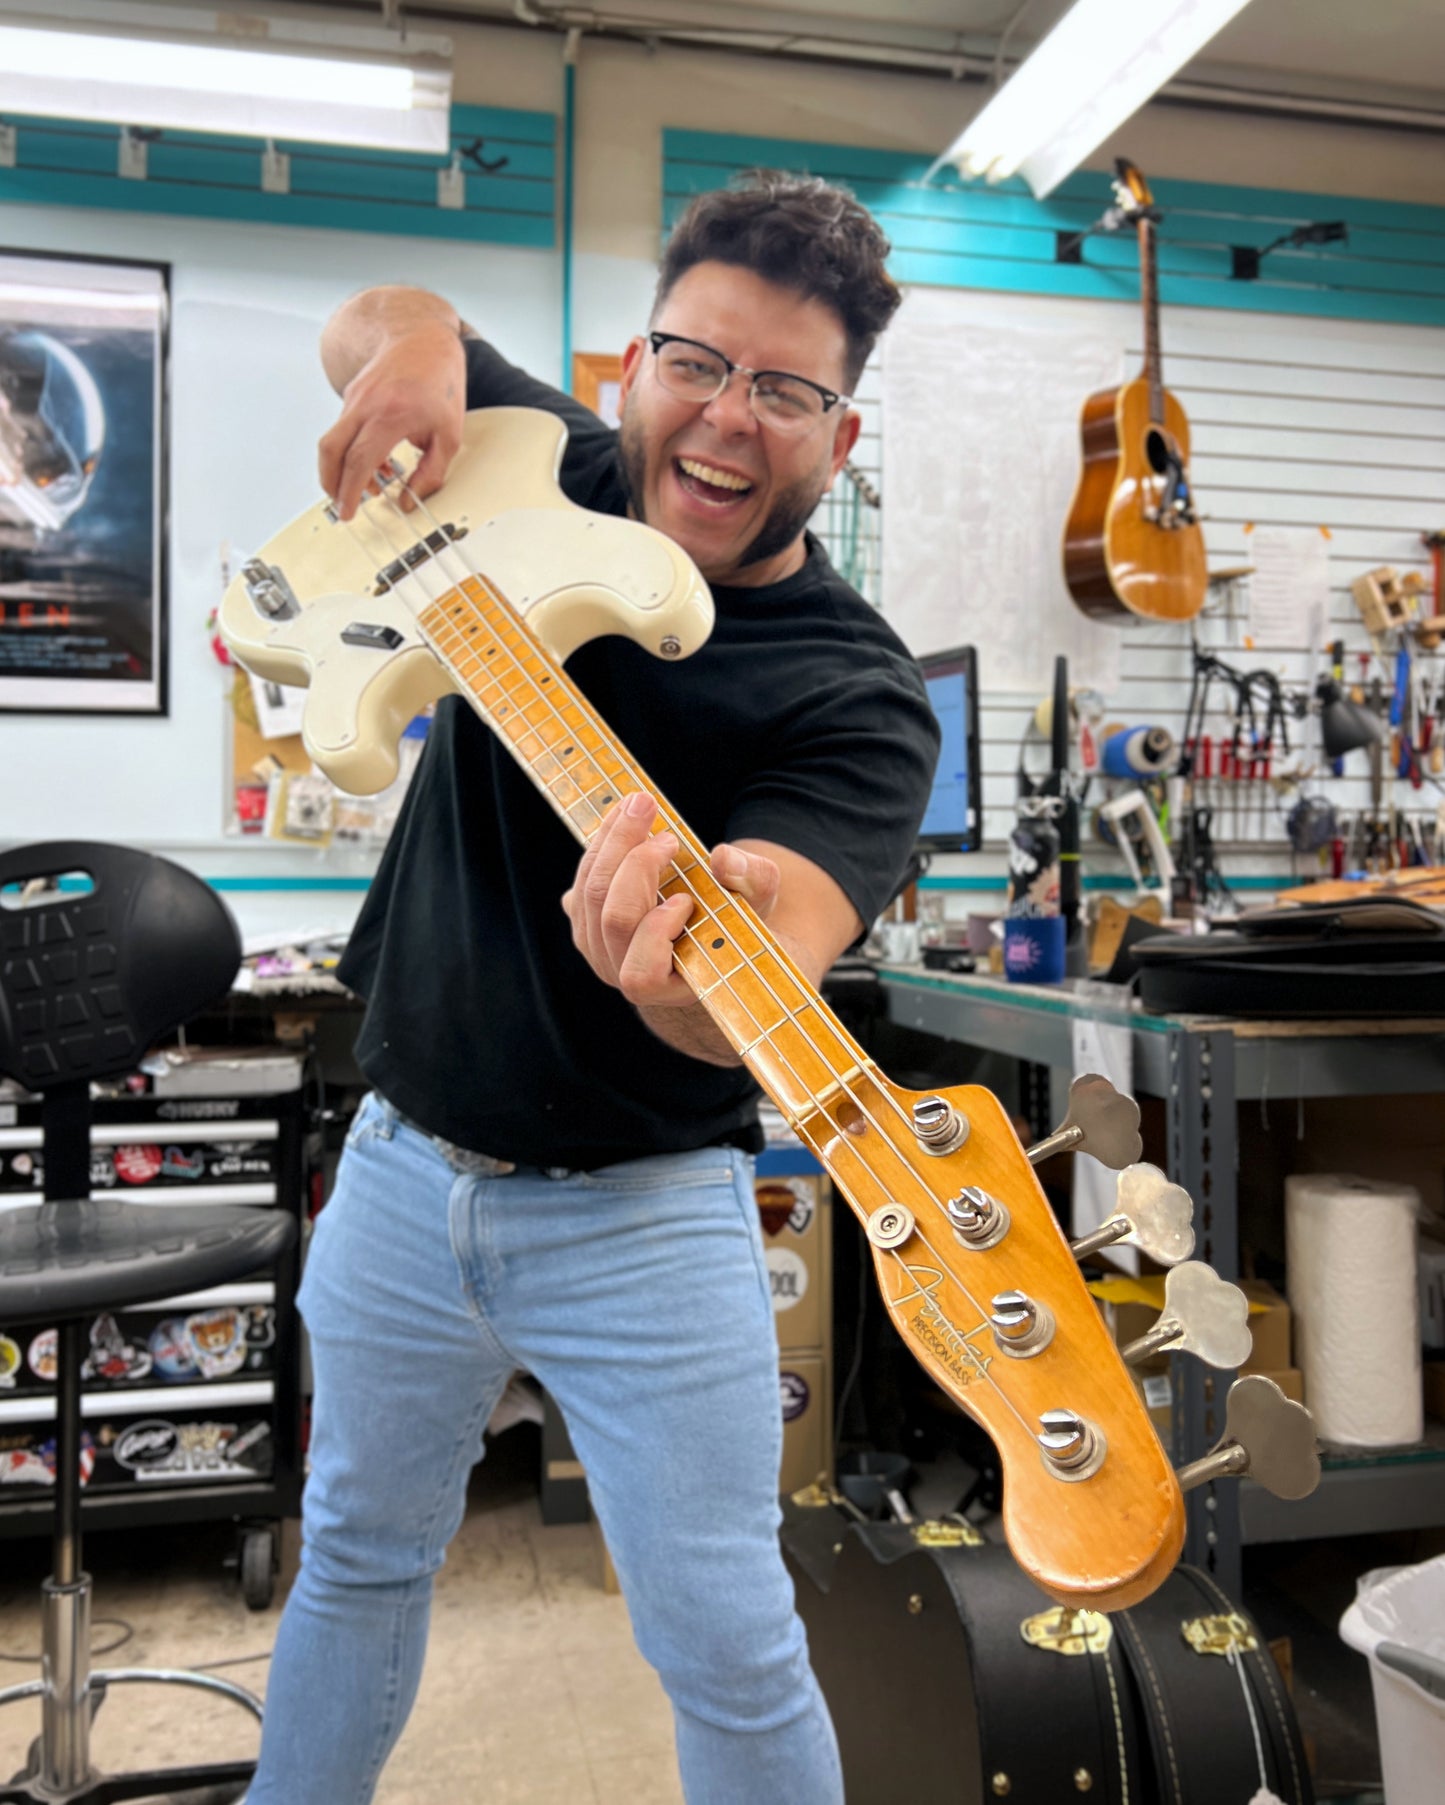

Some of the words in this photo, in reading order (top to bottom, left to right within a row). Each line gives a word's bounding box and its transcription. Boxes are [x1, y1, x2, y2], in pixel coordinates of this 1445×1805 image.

[179, 1100, 239, 1118] HUSKY
[892, 1264, 993, 1378] Fender
[911, 1315, 952, 1362] PRECISION
[948, 1359, 972, 1386] BASS
